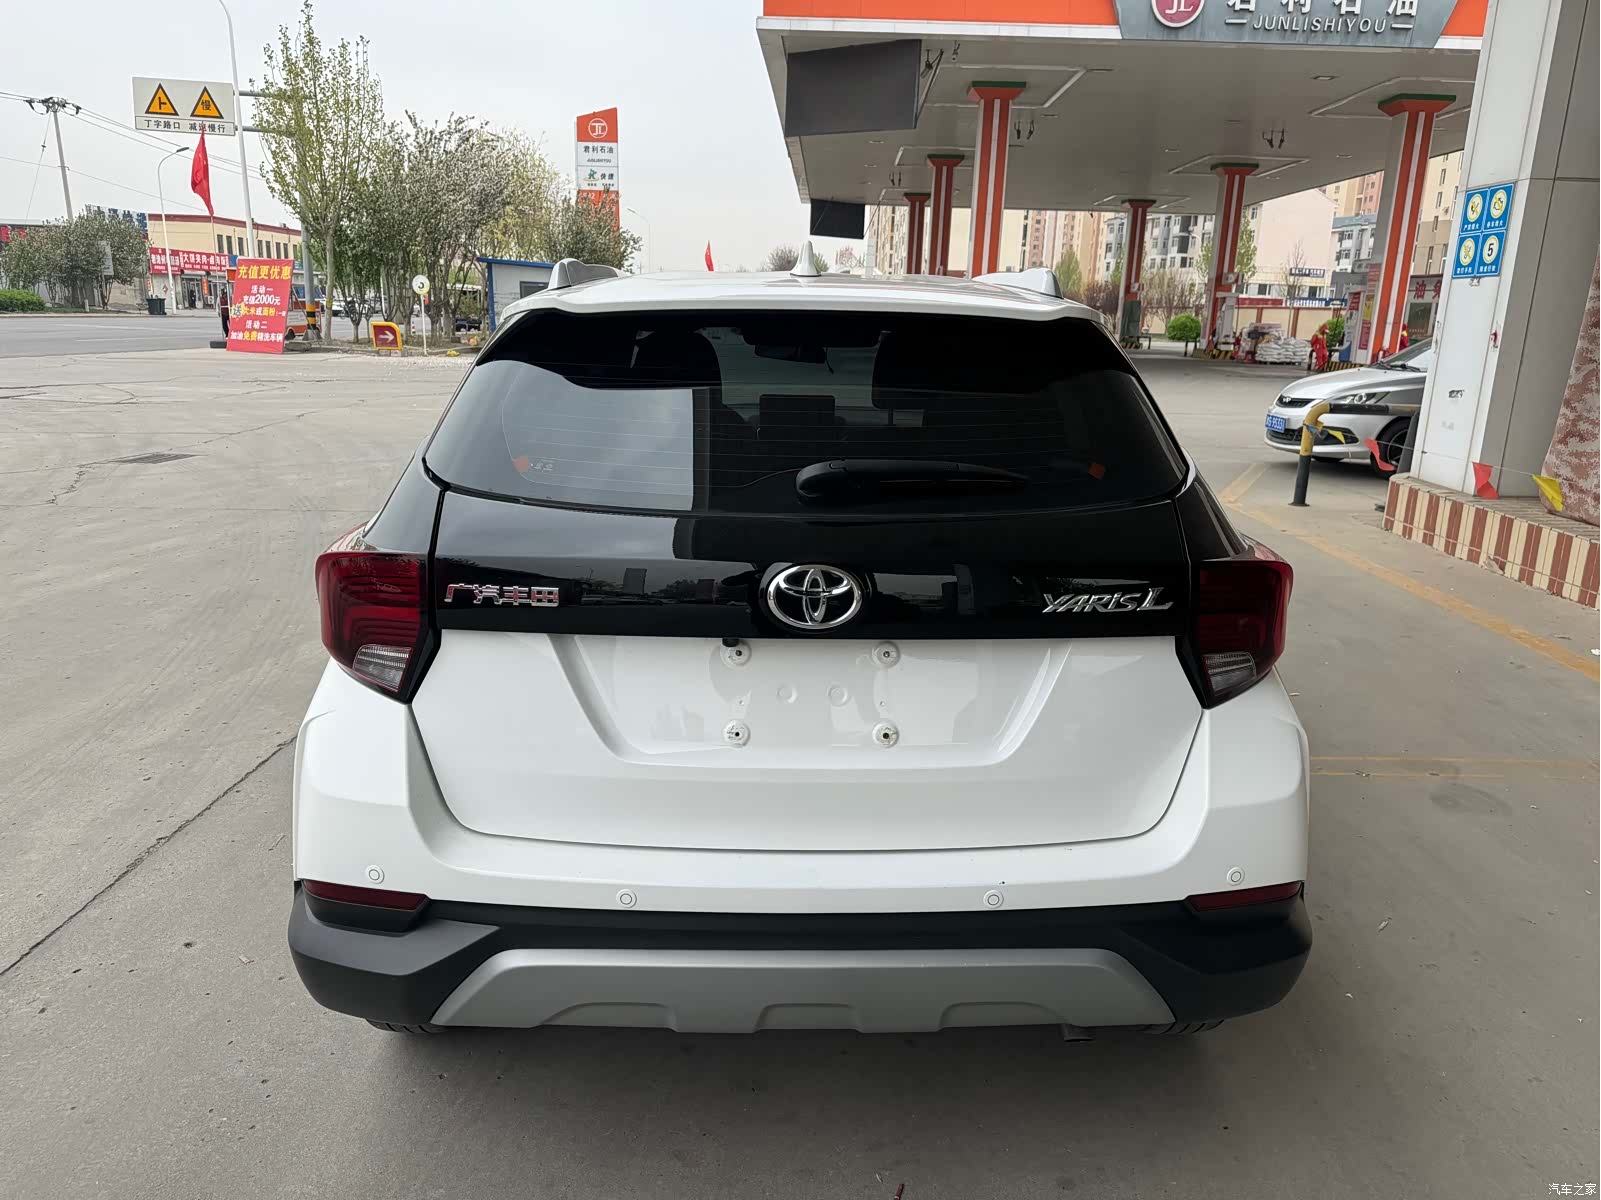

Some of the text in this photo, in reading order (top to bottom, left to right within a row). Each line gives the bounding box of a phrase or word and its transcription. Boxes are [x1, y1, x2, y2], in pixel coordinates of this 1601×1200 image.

[1253, 15, 1386, 33] JUNLISHIYOU
[201, 100, 211, 111] 慢
[145, 119, 226, 133] 丁字路口 减速慢行
[583, 145, 614, 154] 君利石油
[1487, 242, 1495, 257] 5
[238, 265, 292, 280] 充值更优惠
[251, 285, 273, 294] 活动一
[243, 294, 281, 305] 充值2000元
[246, 320, 268, 329] 活动二
[444, 583, 559, 607] 广汽丰田
